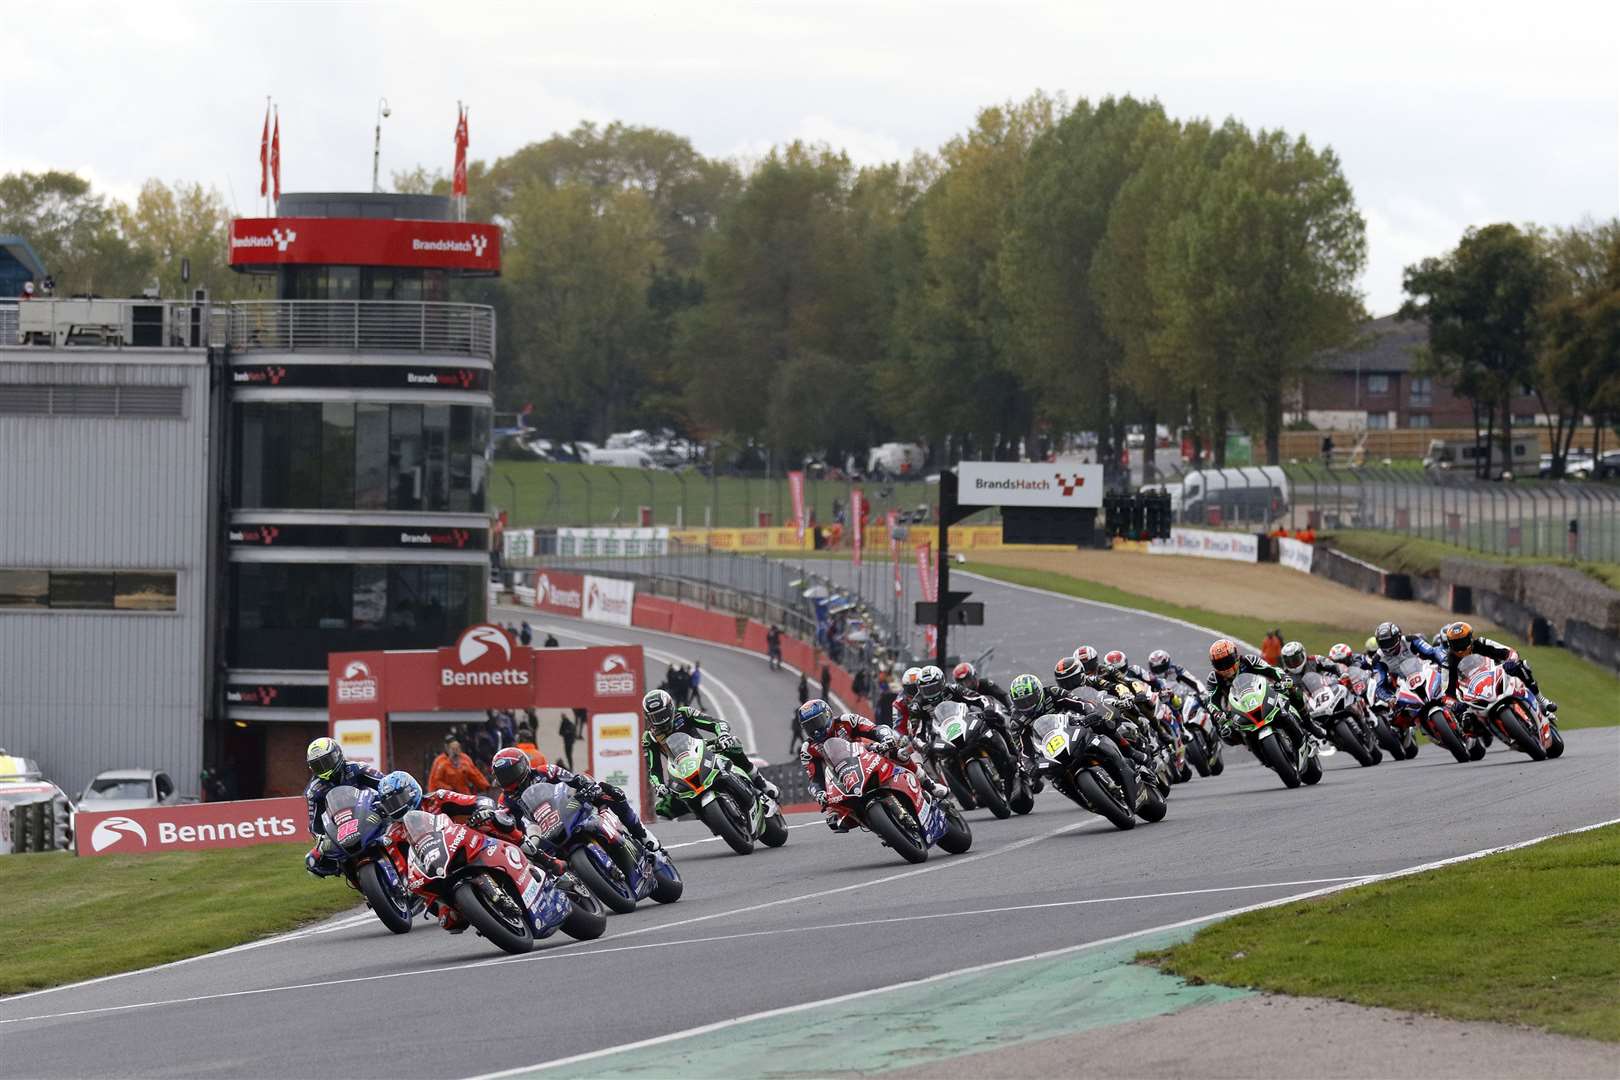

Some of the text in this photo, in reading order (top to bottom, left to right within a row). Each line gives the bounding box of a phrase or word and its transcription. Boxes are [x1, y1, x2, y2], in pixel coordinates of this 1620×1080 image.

[413, 239, 472, 251] BrandsHatch
[976, 479, 1050, 490] BrandsHatch
[442, 669, 529, 686] Bennetts
[596, 680, 634, 692] BSB
[338, 687, 376, 698] BSB
[159, 816, 296, 844] Bennetts
[337, 819, 358, 841] 22
